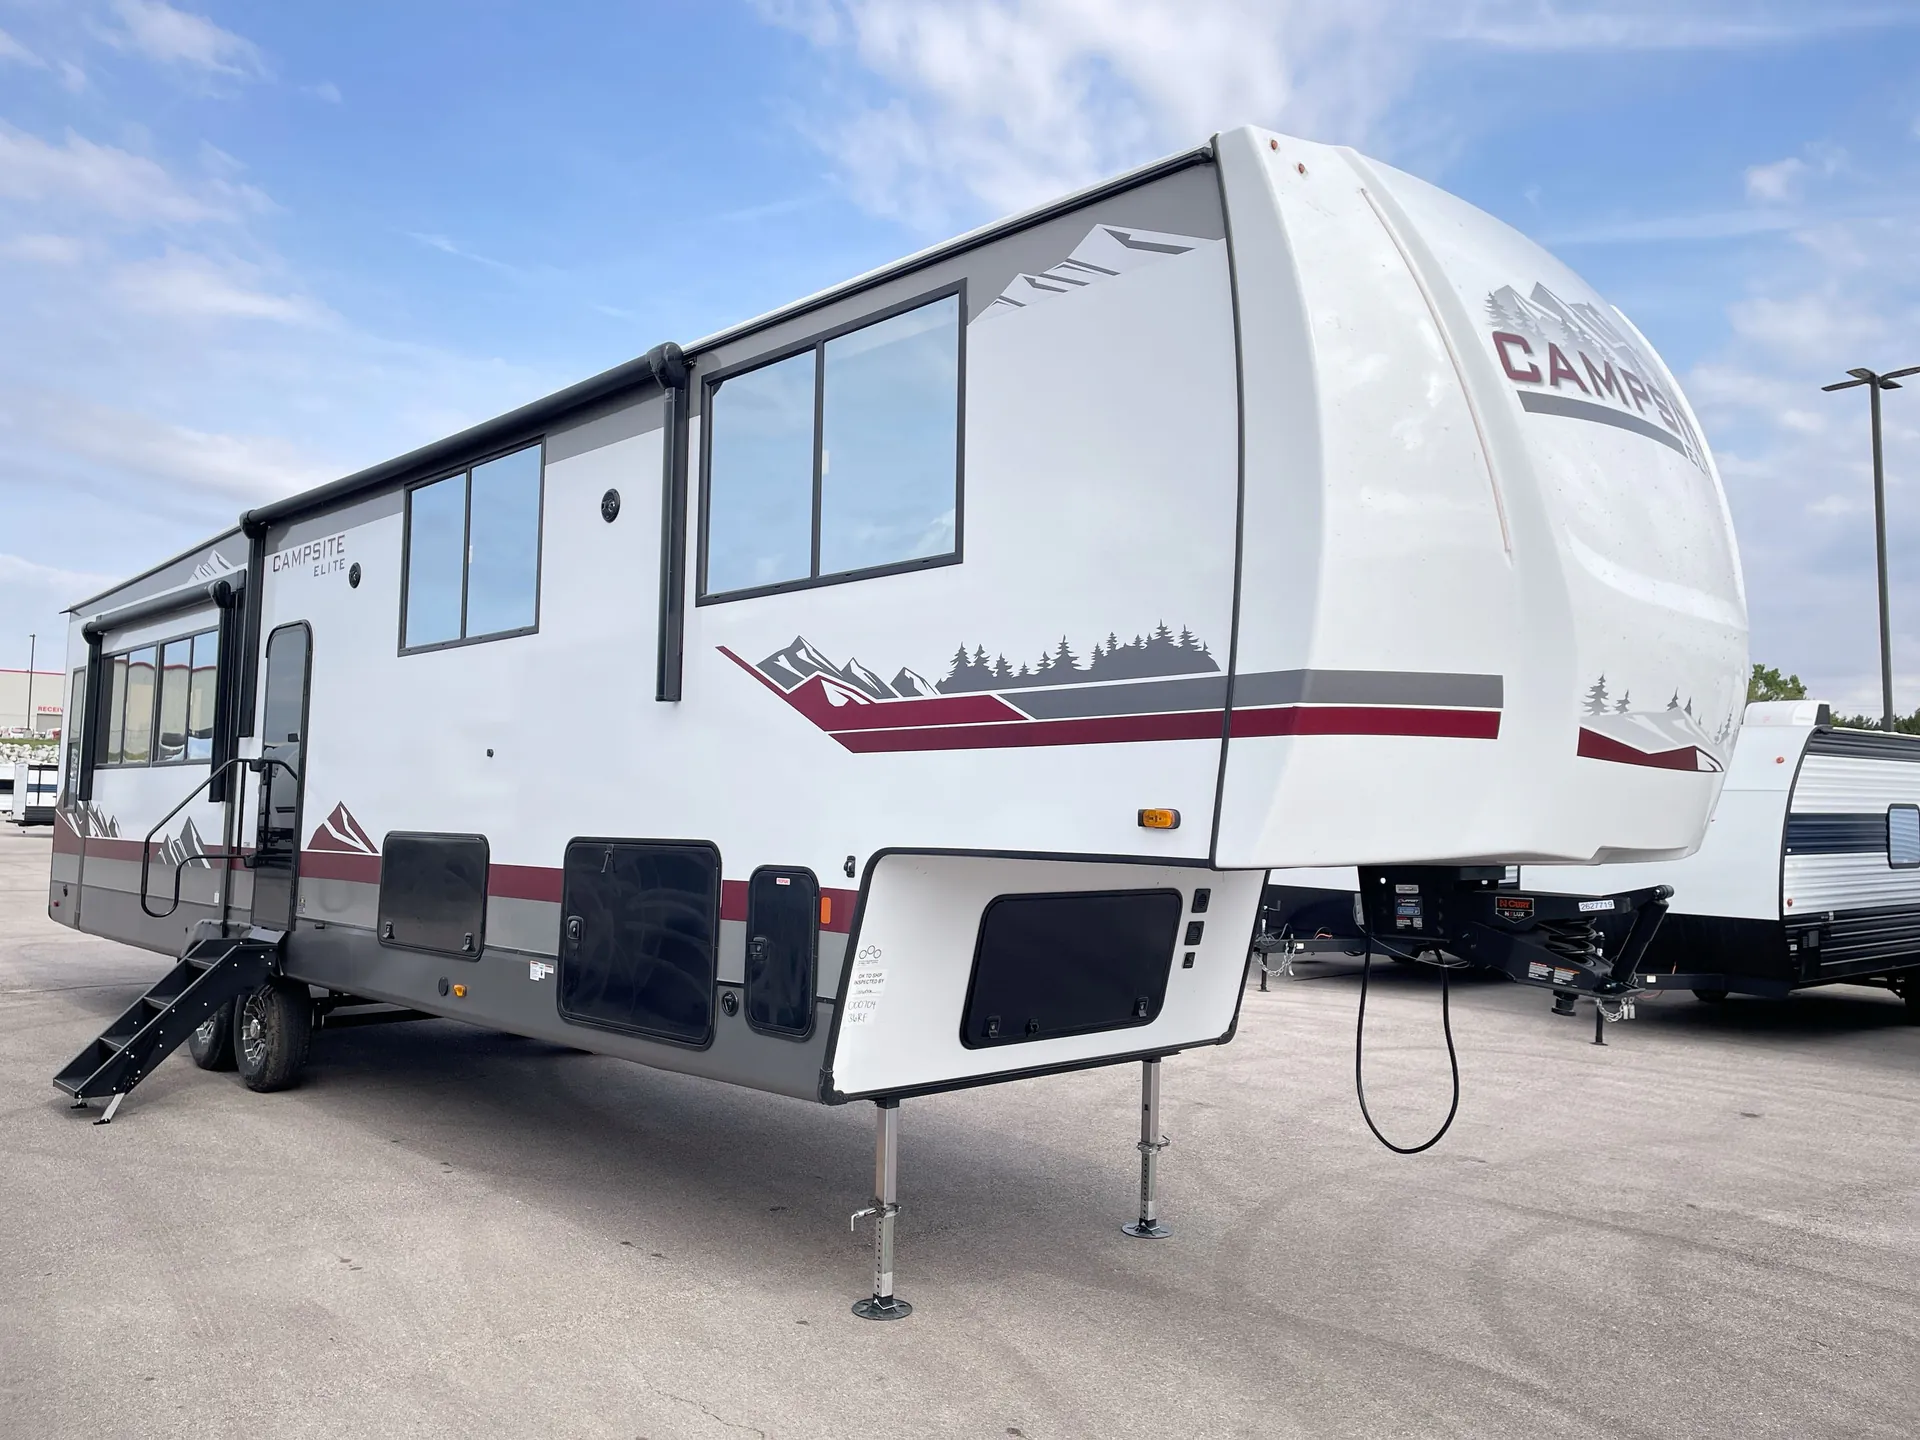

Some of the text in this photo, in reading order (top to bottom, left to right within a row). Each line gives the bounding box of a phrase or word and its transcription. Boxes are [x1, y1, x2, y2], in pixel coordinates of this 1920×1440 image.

[273, 535, 345, 572] CAMPSITE
[313, 558, 345, 577] ELITE
[1580, 901, 1613, 910] 2627719
